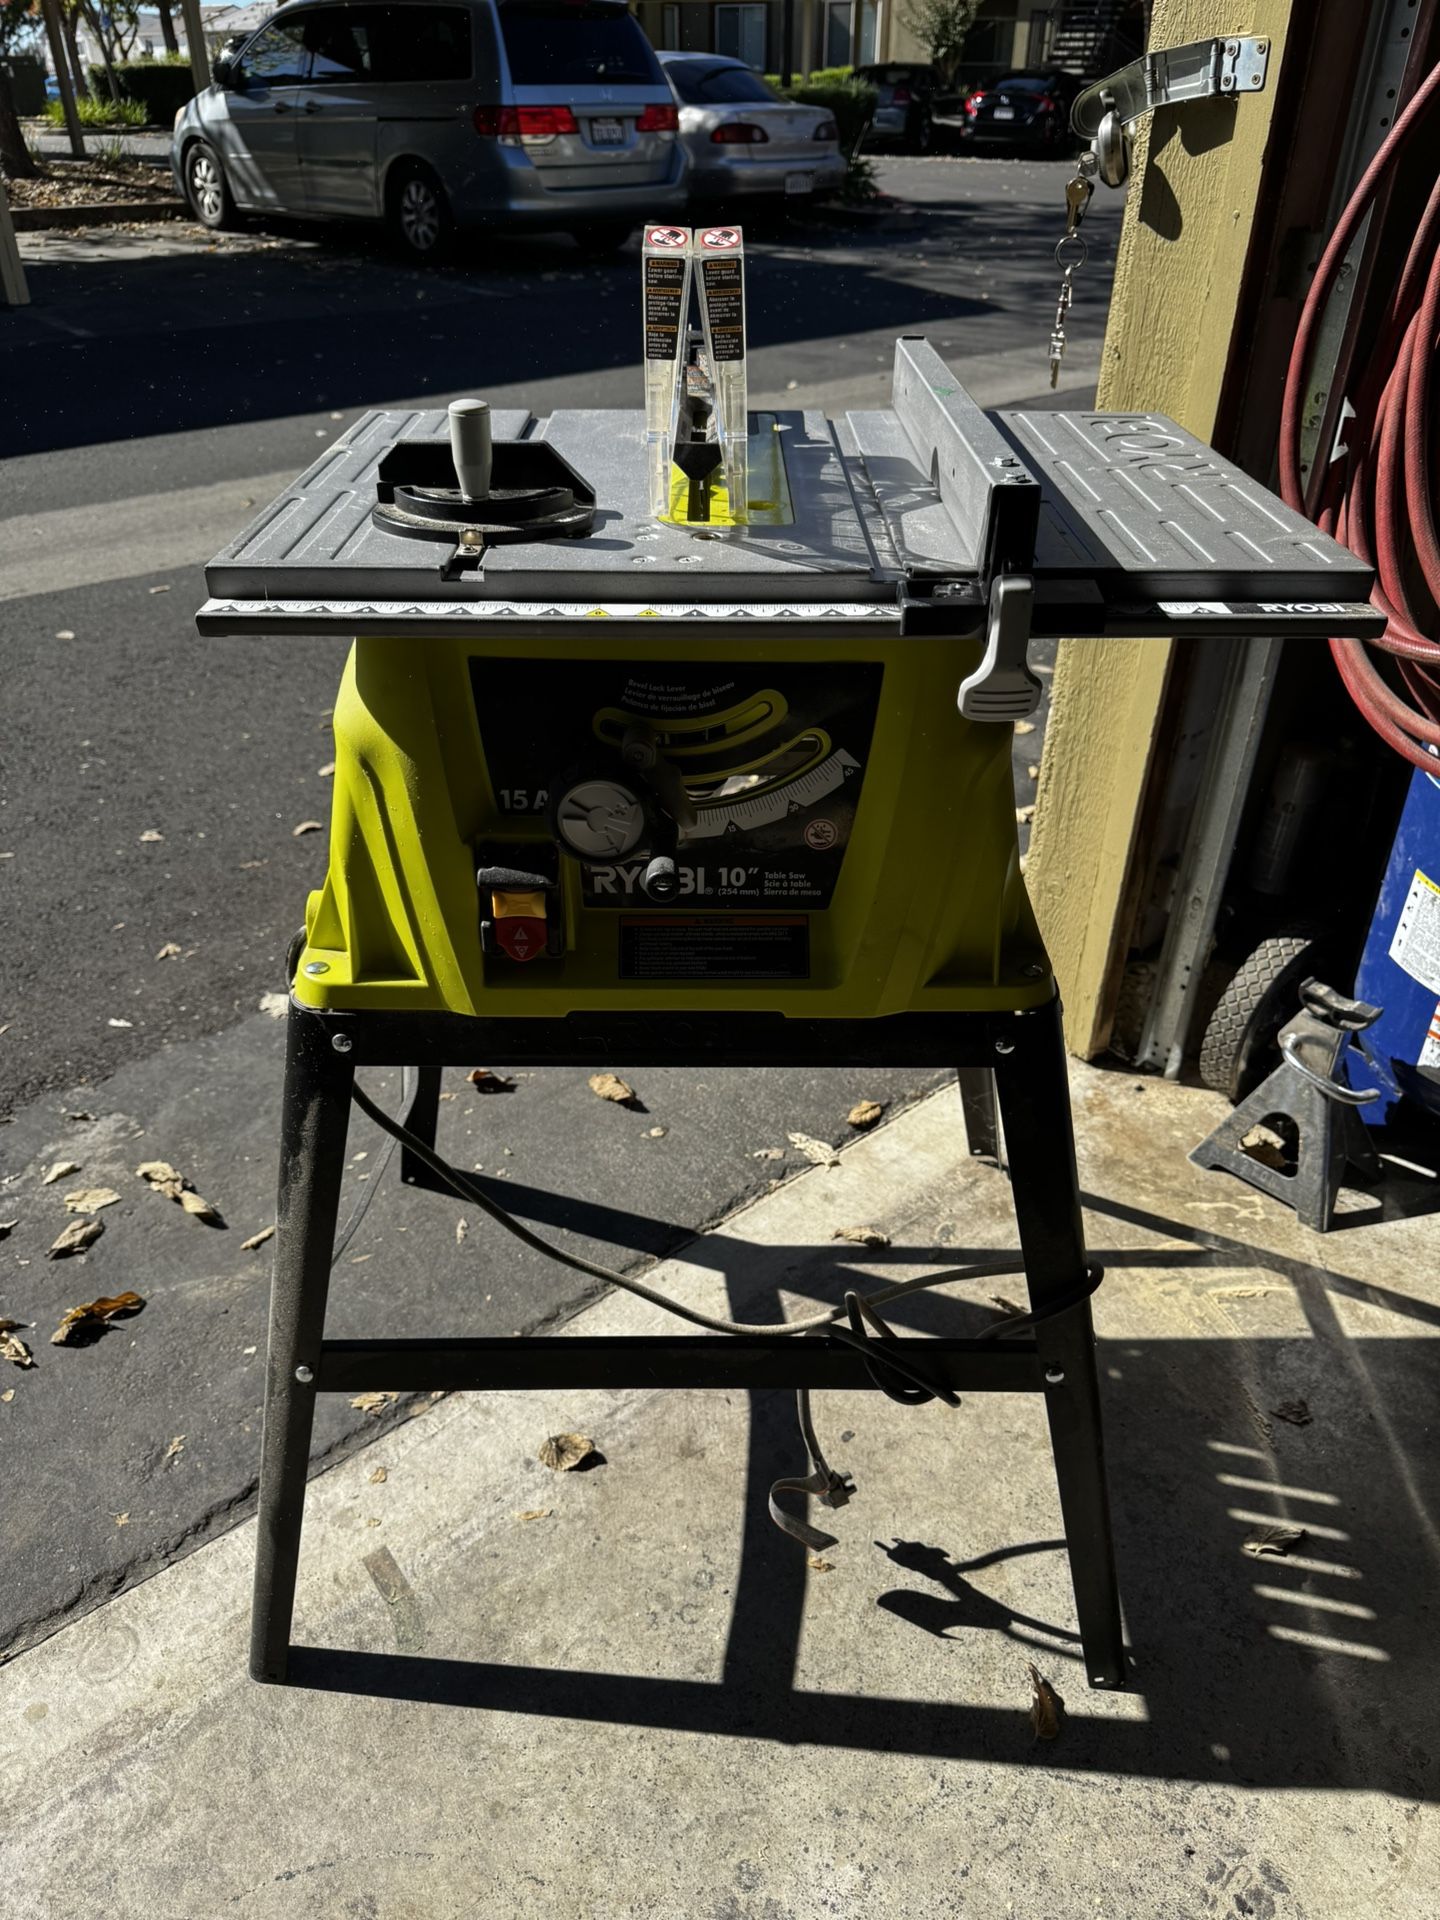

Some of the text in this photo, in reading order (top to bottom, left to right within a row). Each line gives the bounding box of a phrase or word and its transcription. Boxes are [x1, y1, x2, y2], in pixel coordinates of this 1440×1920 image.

[1081, 415, 1228, 481] RYOBI
[1257, 603, 1346, 613] RYOBI
[628, 679, 648, 690] Bevel
[649, 684, 665, 692] Lock
[499, 788, 529, 810] 15
[727, 824, 736, 833] 15
[764, 871, 806, 879] Table Saw
[764, 880, 780, 888] Scie
[790, 880, 812, 888] table
[718, 888, 760, 897] (254 mm)
[763, 888, 788, 896] Sierra
[788, 888, 799, 896] de
